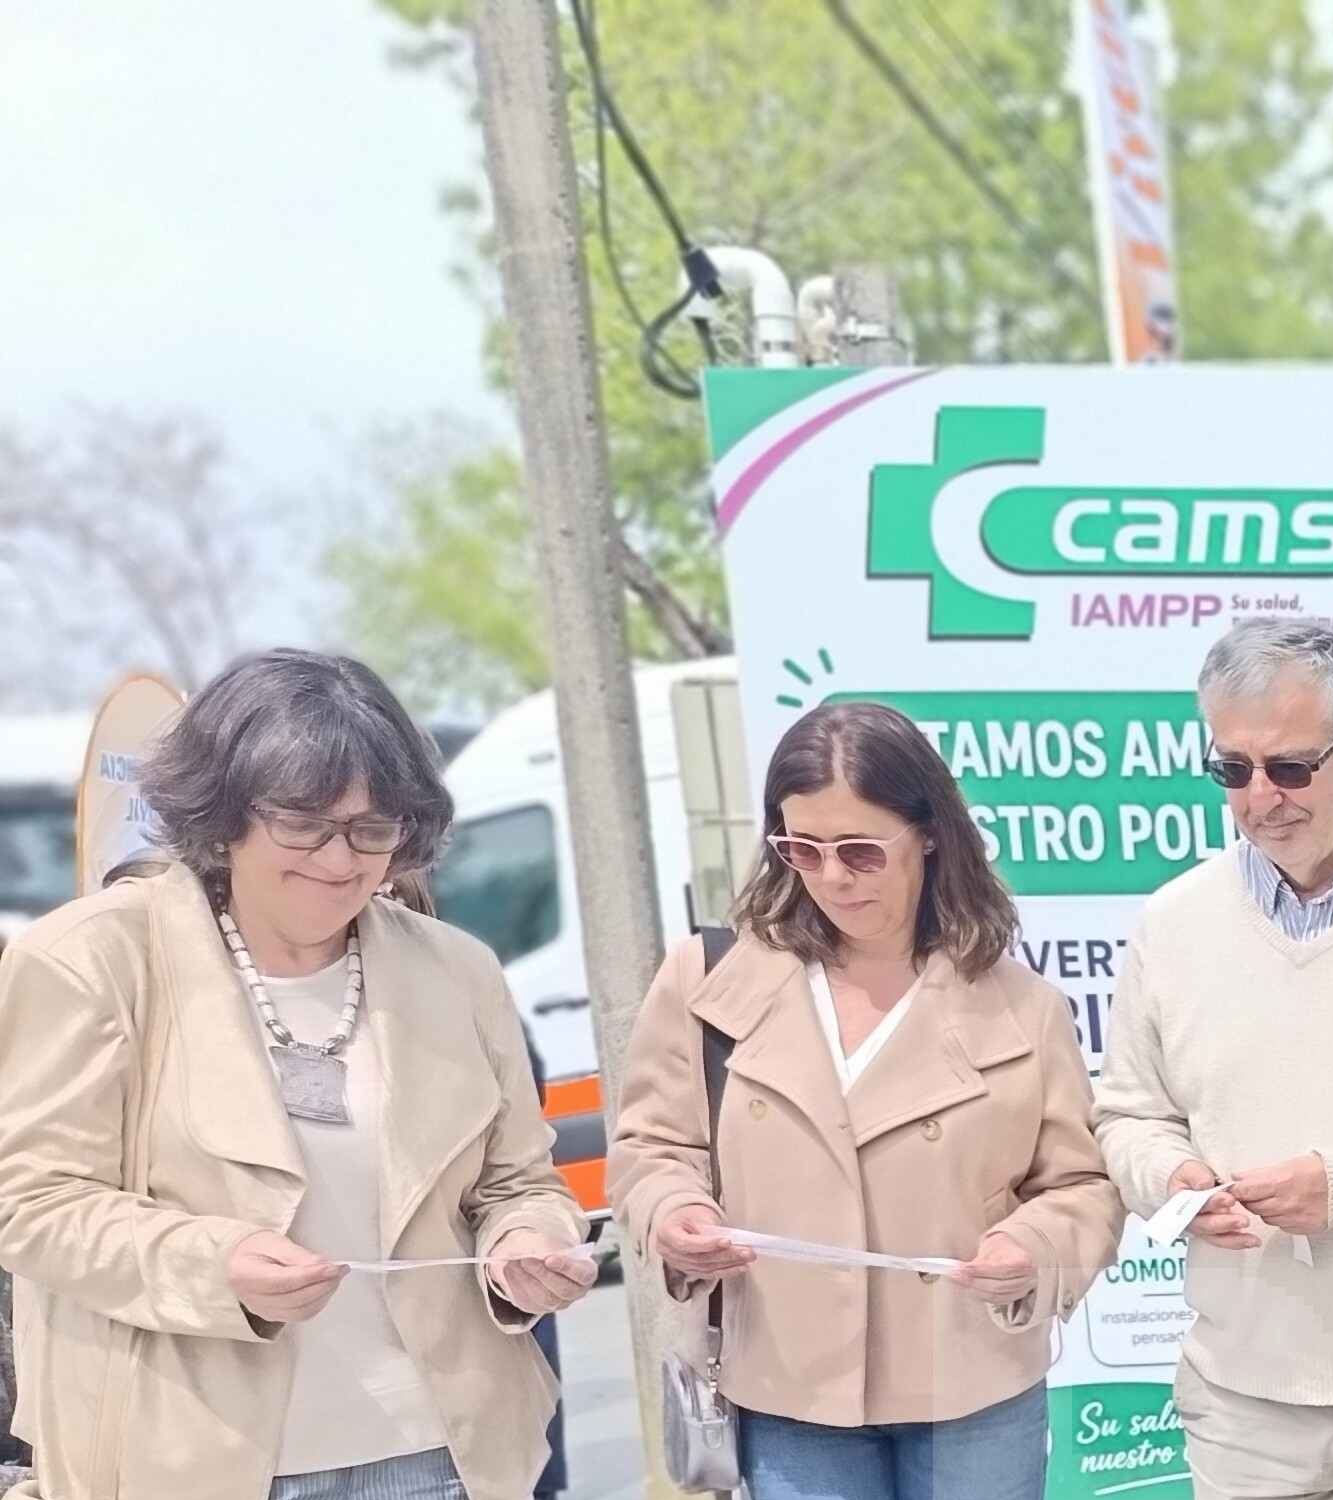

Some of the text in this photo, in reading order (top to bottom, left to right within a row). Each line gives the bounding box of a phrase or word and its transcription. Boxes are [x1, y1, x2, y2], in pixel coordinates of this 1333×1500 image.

[1070, 594, 1222, 628] IAMPP
[1231, 593, 1250, 610] Su
[916, 719, 1107, 779] TAMOS
[968, 803, 1105, 862] STRO
[1101, 1309, 1195, 1324] instalaciones
[1077, 1399, 1184, 1444] Su salu
[1080, 1439, 1176, 1474] nuestro
